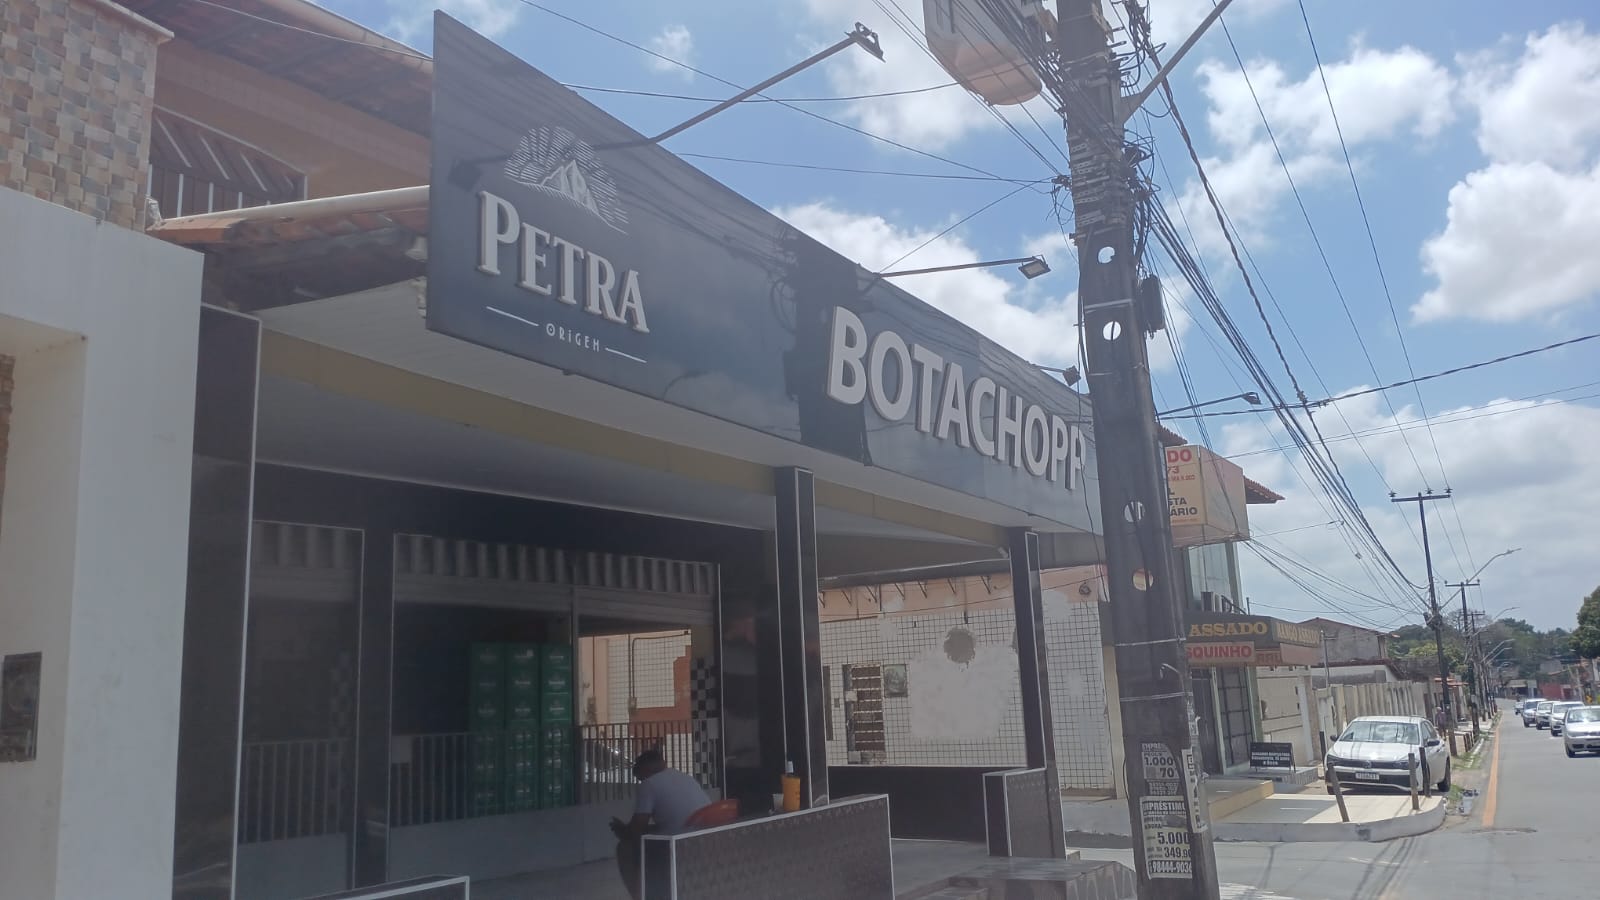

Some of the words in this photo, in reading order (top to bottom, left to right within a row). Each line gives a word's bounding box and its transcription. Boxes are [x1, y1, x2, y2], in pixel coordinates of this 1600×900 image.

[476, 190, 650, 334] PETRA
[827, 305, 1086, 490] BOTACHOPP
[1188, 621, 1268, 637] ASSADO
[1144, 756, 1174, 766] 1.000
[1160, 768, 1174, 777] 70
